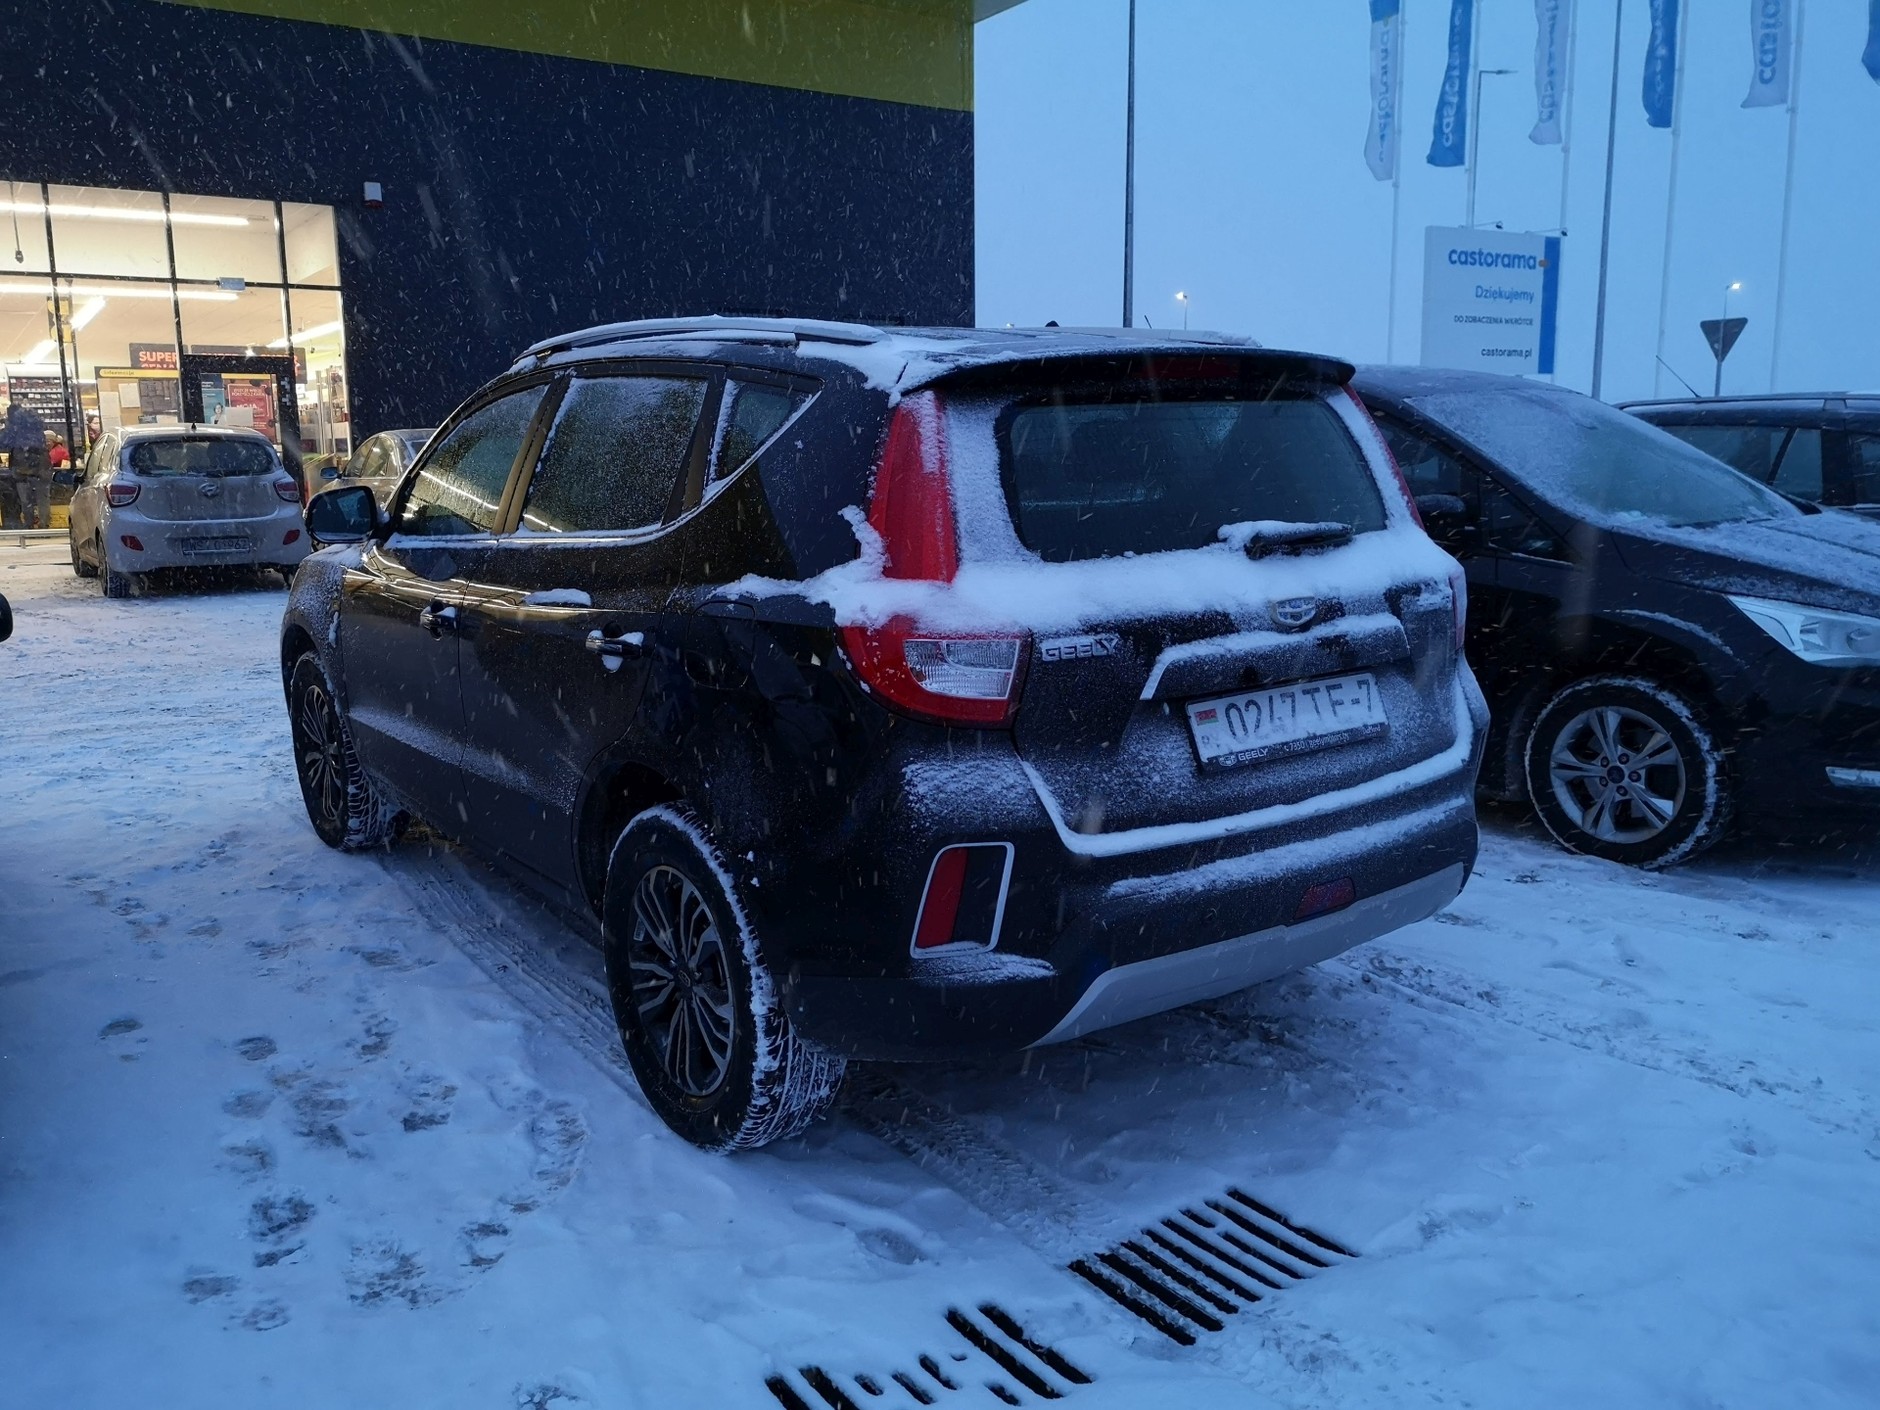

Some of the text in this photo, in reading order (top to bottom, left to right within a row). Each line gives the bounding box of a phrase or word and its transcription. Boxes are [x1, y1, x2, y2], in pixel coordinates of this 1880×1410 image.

[1448, 248, 1537, 270] castorama
[1475, 285, 1534, 304] Dziękujemy
[1454, 315, 1464, 323] DO
[1465, 315, 1503, 325] ZOBACZENIA
[1481, 347, 1533, 360] castorama.pl
[1040, 634, 1119, 661] GEELY
[1238, 747, 1269, 760] GEELY
